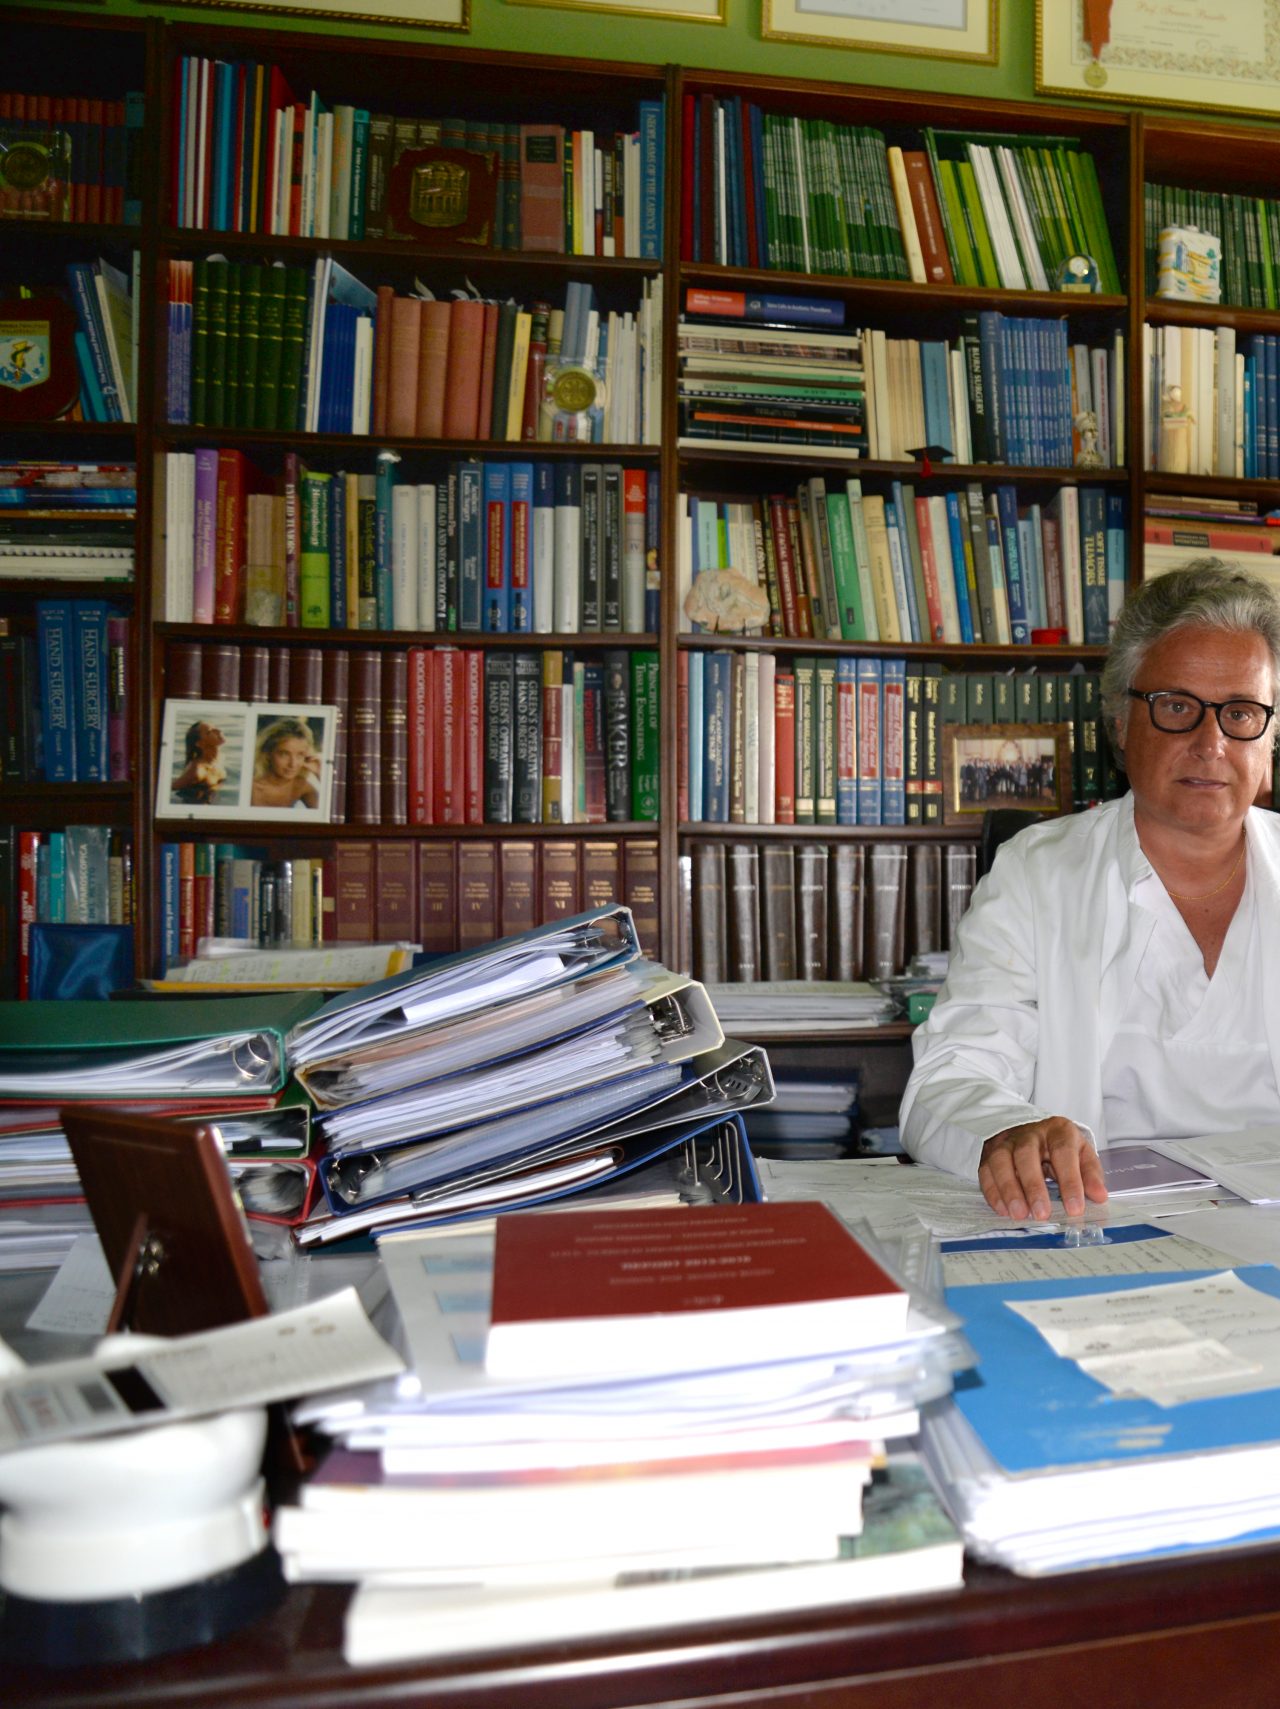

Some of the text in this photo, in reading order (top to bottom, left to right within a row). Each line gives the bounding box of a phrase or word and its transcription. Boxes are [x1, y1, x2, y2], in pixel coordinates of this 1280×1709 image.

[646, 113, 657, 162] NEOPLASMS
[646, 196, 657, 230] LARYNX
[972, 347, 985, 416] BURN SURGERY
[286, 484, 296, 555] EYELID TUMORS
[311, 489, 321, 546] Histopathology
[437, 503, 447, 526] HEAD
[463, 497, 471, 522] Surgery
[365, 560, 375, 594] Surgery
[437, 548, 447, 568] NECK
[778, 533, 788, 560] FACIAL
[1085, 536, 1096, 586] TUMORS
[1096, 531, 1106, 586] SOFT TISSUE
[48, 628, 64, 729] HAND SURGERY
[84, 628, 99, 729] HAND SURGERY
[647, 663, 659, 714] PRINCIPLES
[489, 681, 499, 761] HAND SURGERY
[499, 680, 510, 781] GREEN'S OPERATIVE
[518, 681, 528, 761] HAND SURGERY
[528, 680, 538, 781] GREEN'S OPERATIVE
[609, 696, 628, 770] BAKER
[635, 663, 647, 761] TISSUE ENGINEERING
[79, 844, 89, 915] LAPAROSCOPICA
